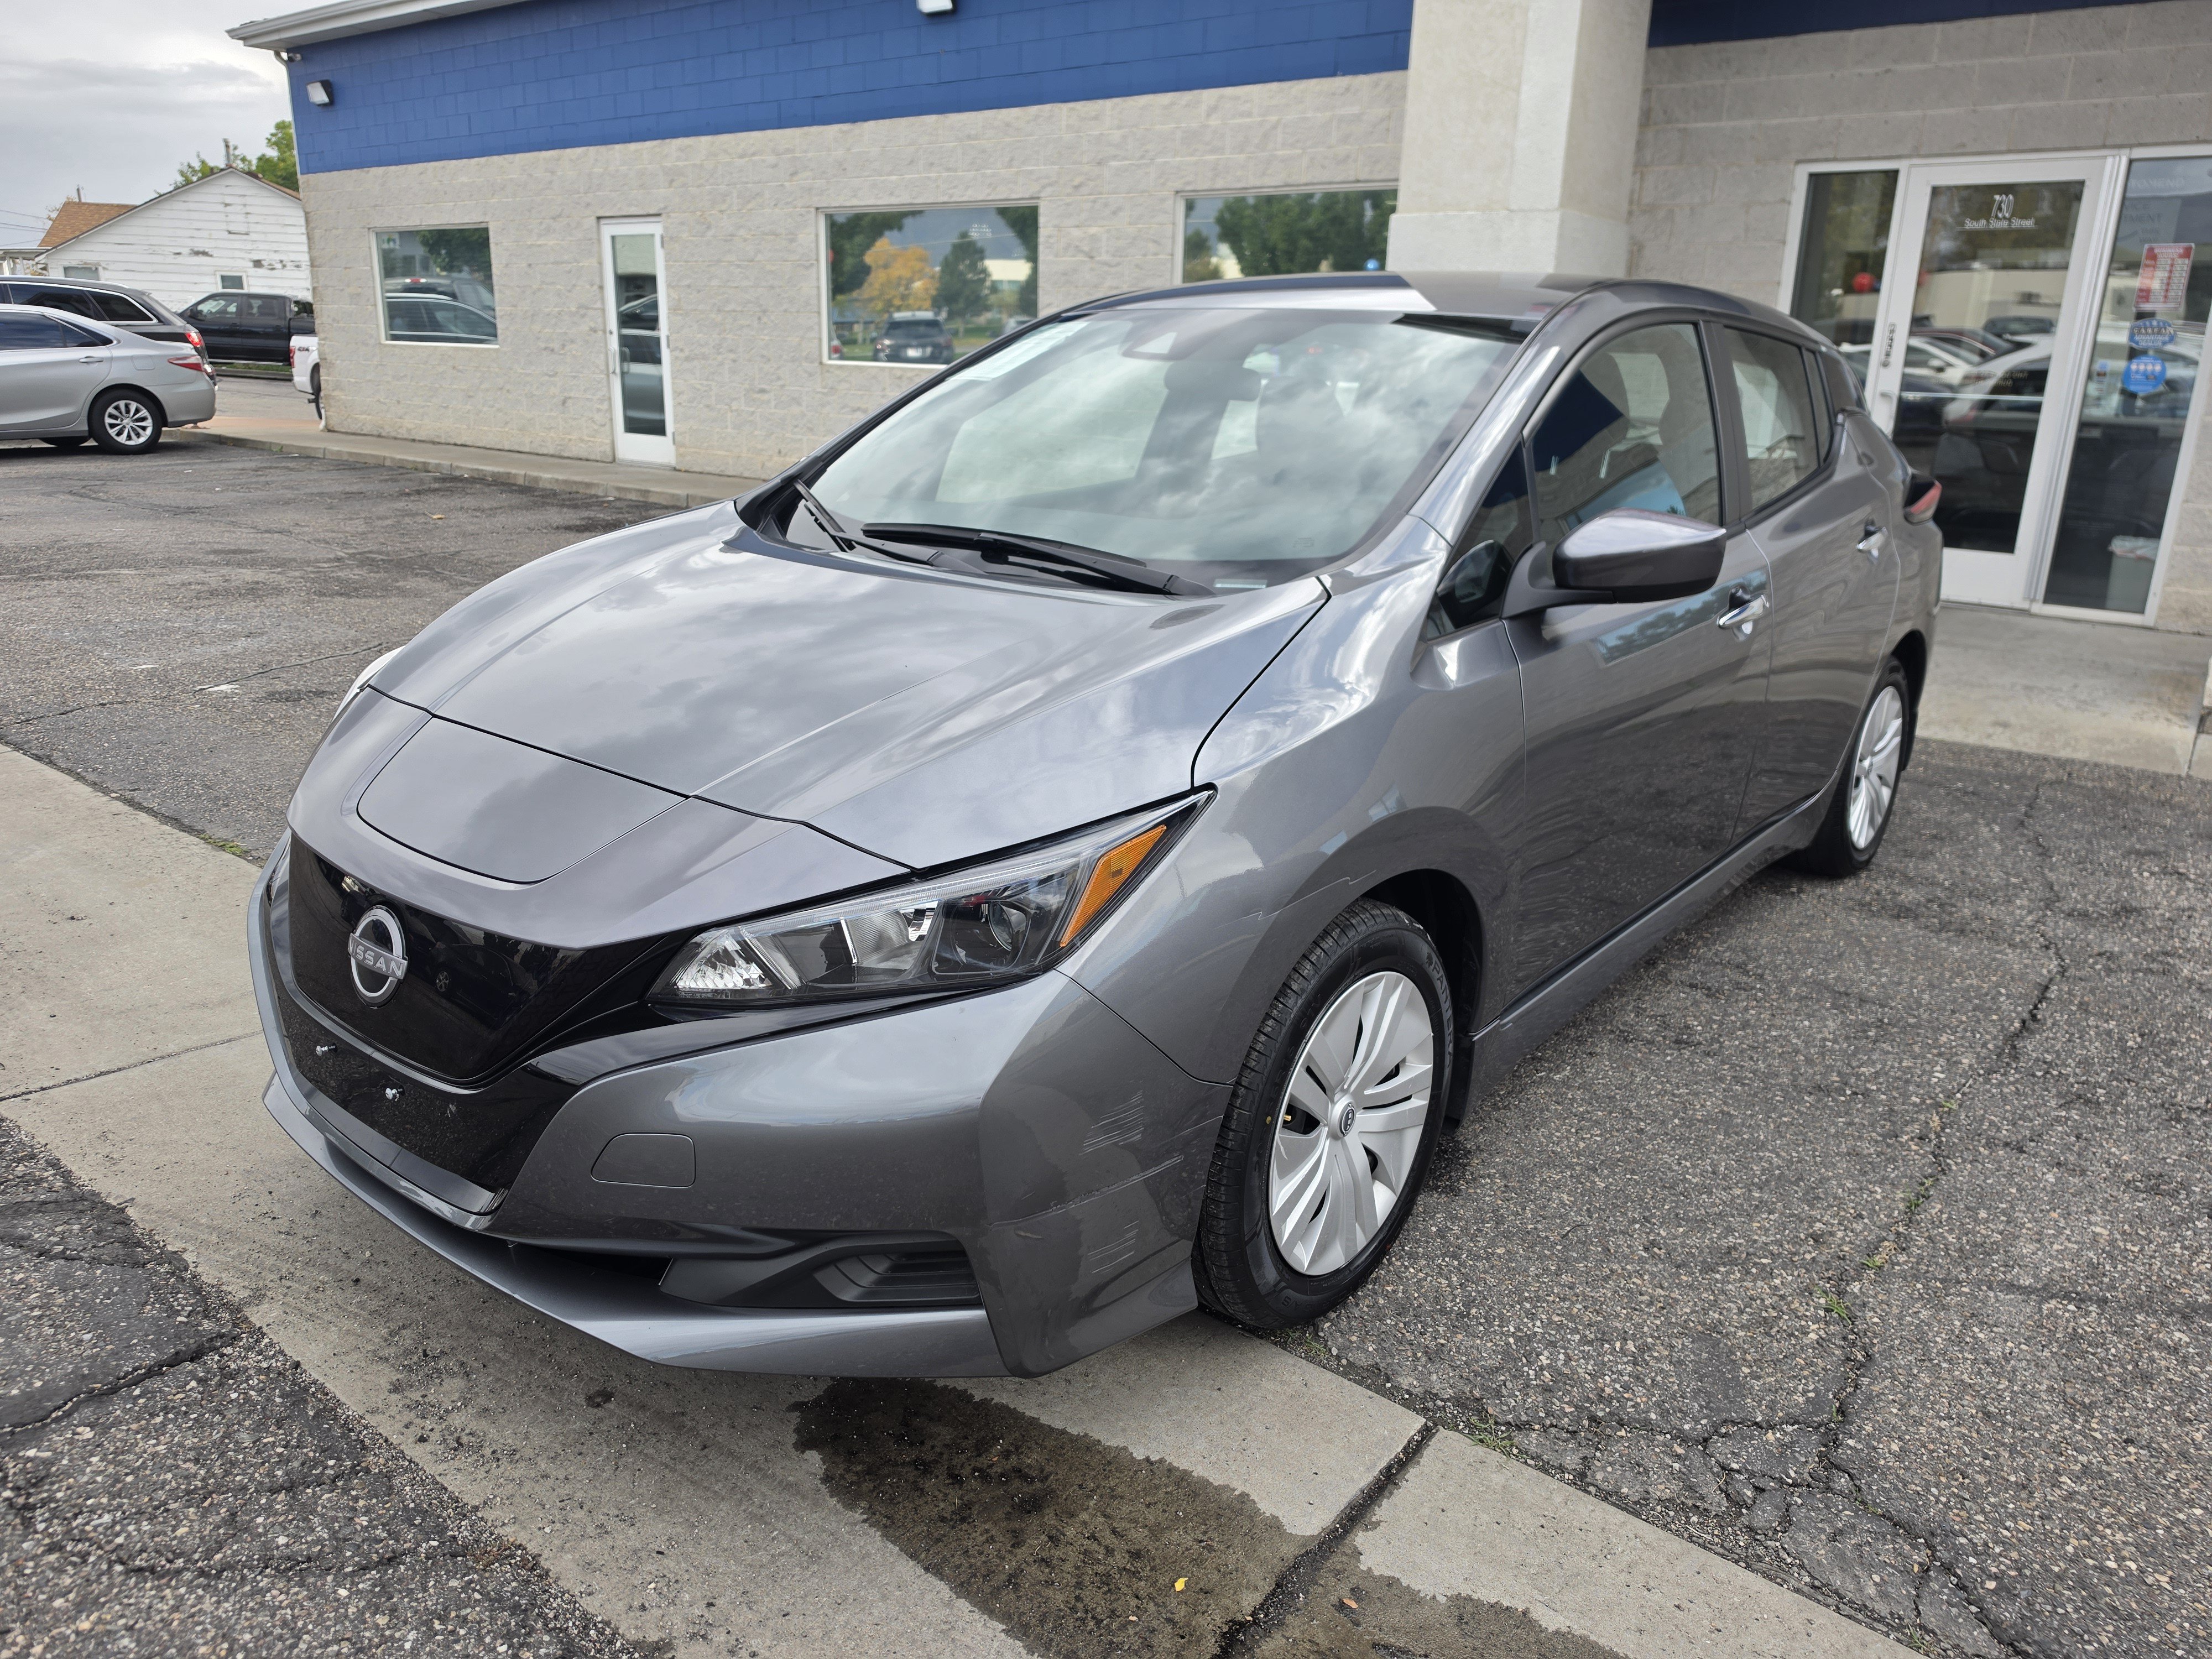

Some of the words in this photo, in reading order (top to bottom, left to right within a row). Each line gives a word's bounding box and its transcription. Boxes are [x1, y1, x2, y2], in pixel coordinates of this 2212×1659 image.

[1991, 194, 2015, 218] 730
[1965, 218, 1986, 229] South
[1989, 217, 2008, 228] State
[2011, 216, 2035, 227] Street
[348, 940, 403, 977] NISSAN
[1432, 959, 1453, 1068] PANTERA
